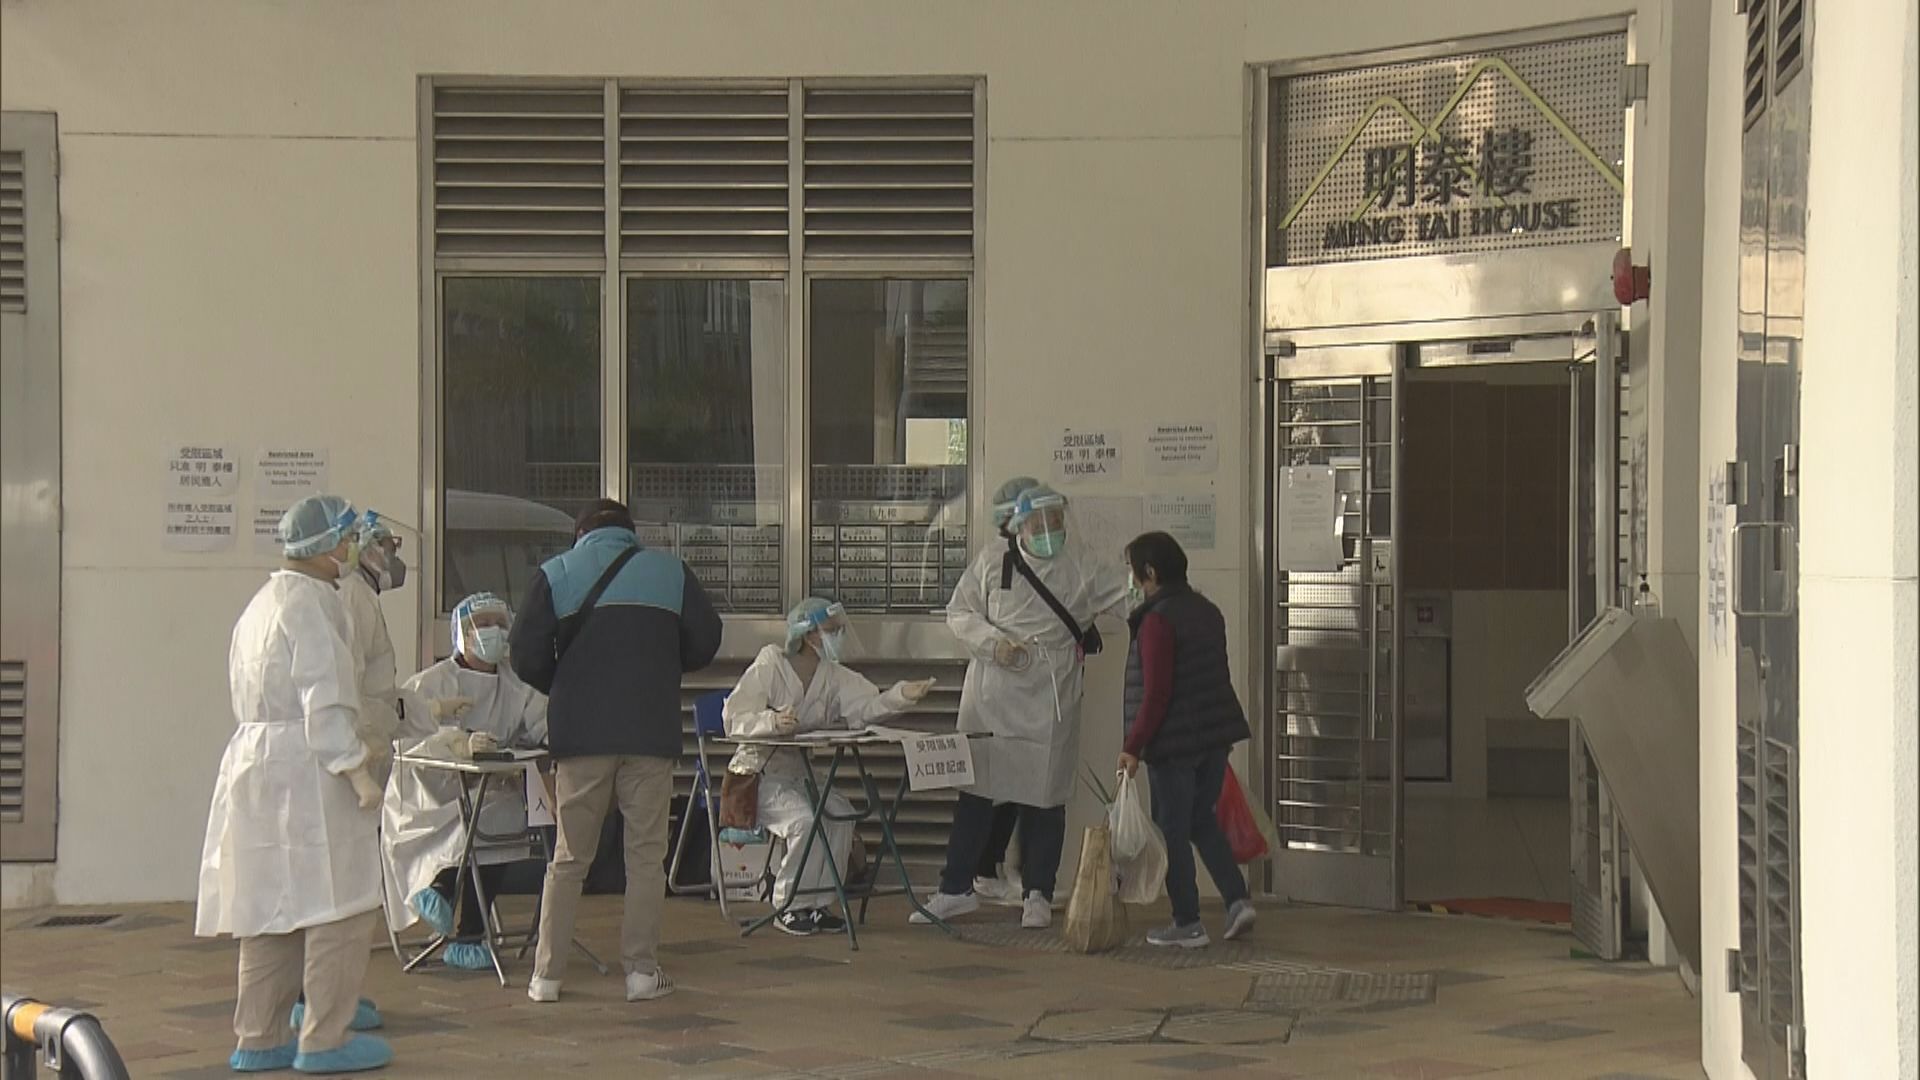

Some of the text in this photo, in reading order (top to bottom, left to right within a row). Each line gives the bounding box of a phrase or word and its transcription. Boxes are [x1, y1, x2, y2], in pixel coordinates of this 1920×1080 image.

[1362, 127, 1536, 209] 明泰樓
[1322, 198, 1582, 250] MING TAI HOUSE
[1063, 433, 1105, 447] 受限區域
[180, 447, 223, 459] 受限區域
[1053, 449, 1073, 460] 只准
[916, 738, 956, 752] 受限區域
[915, 760, 967, 777] 入口登記處
